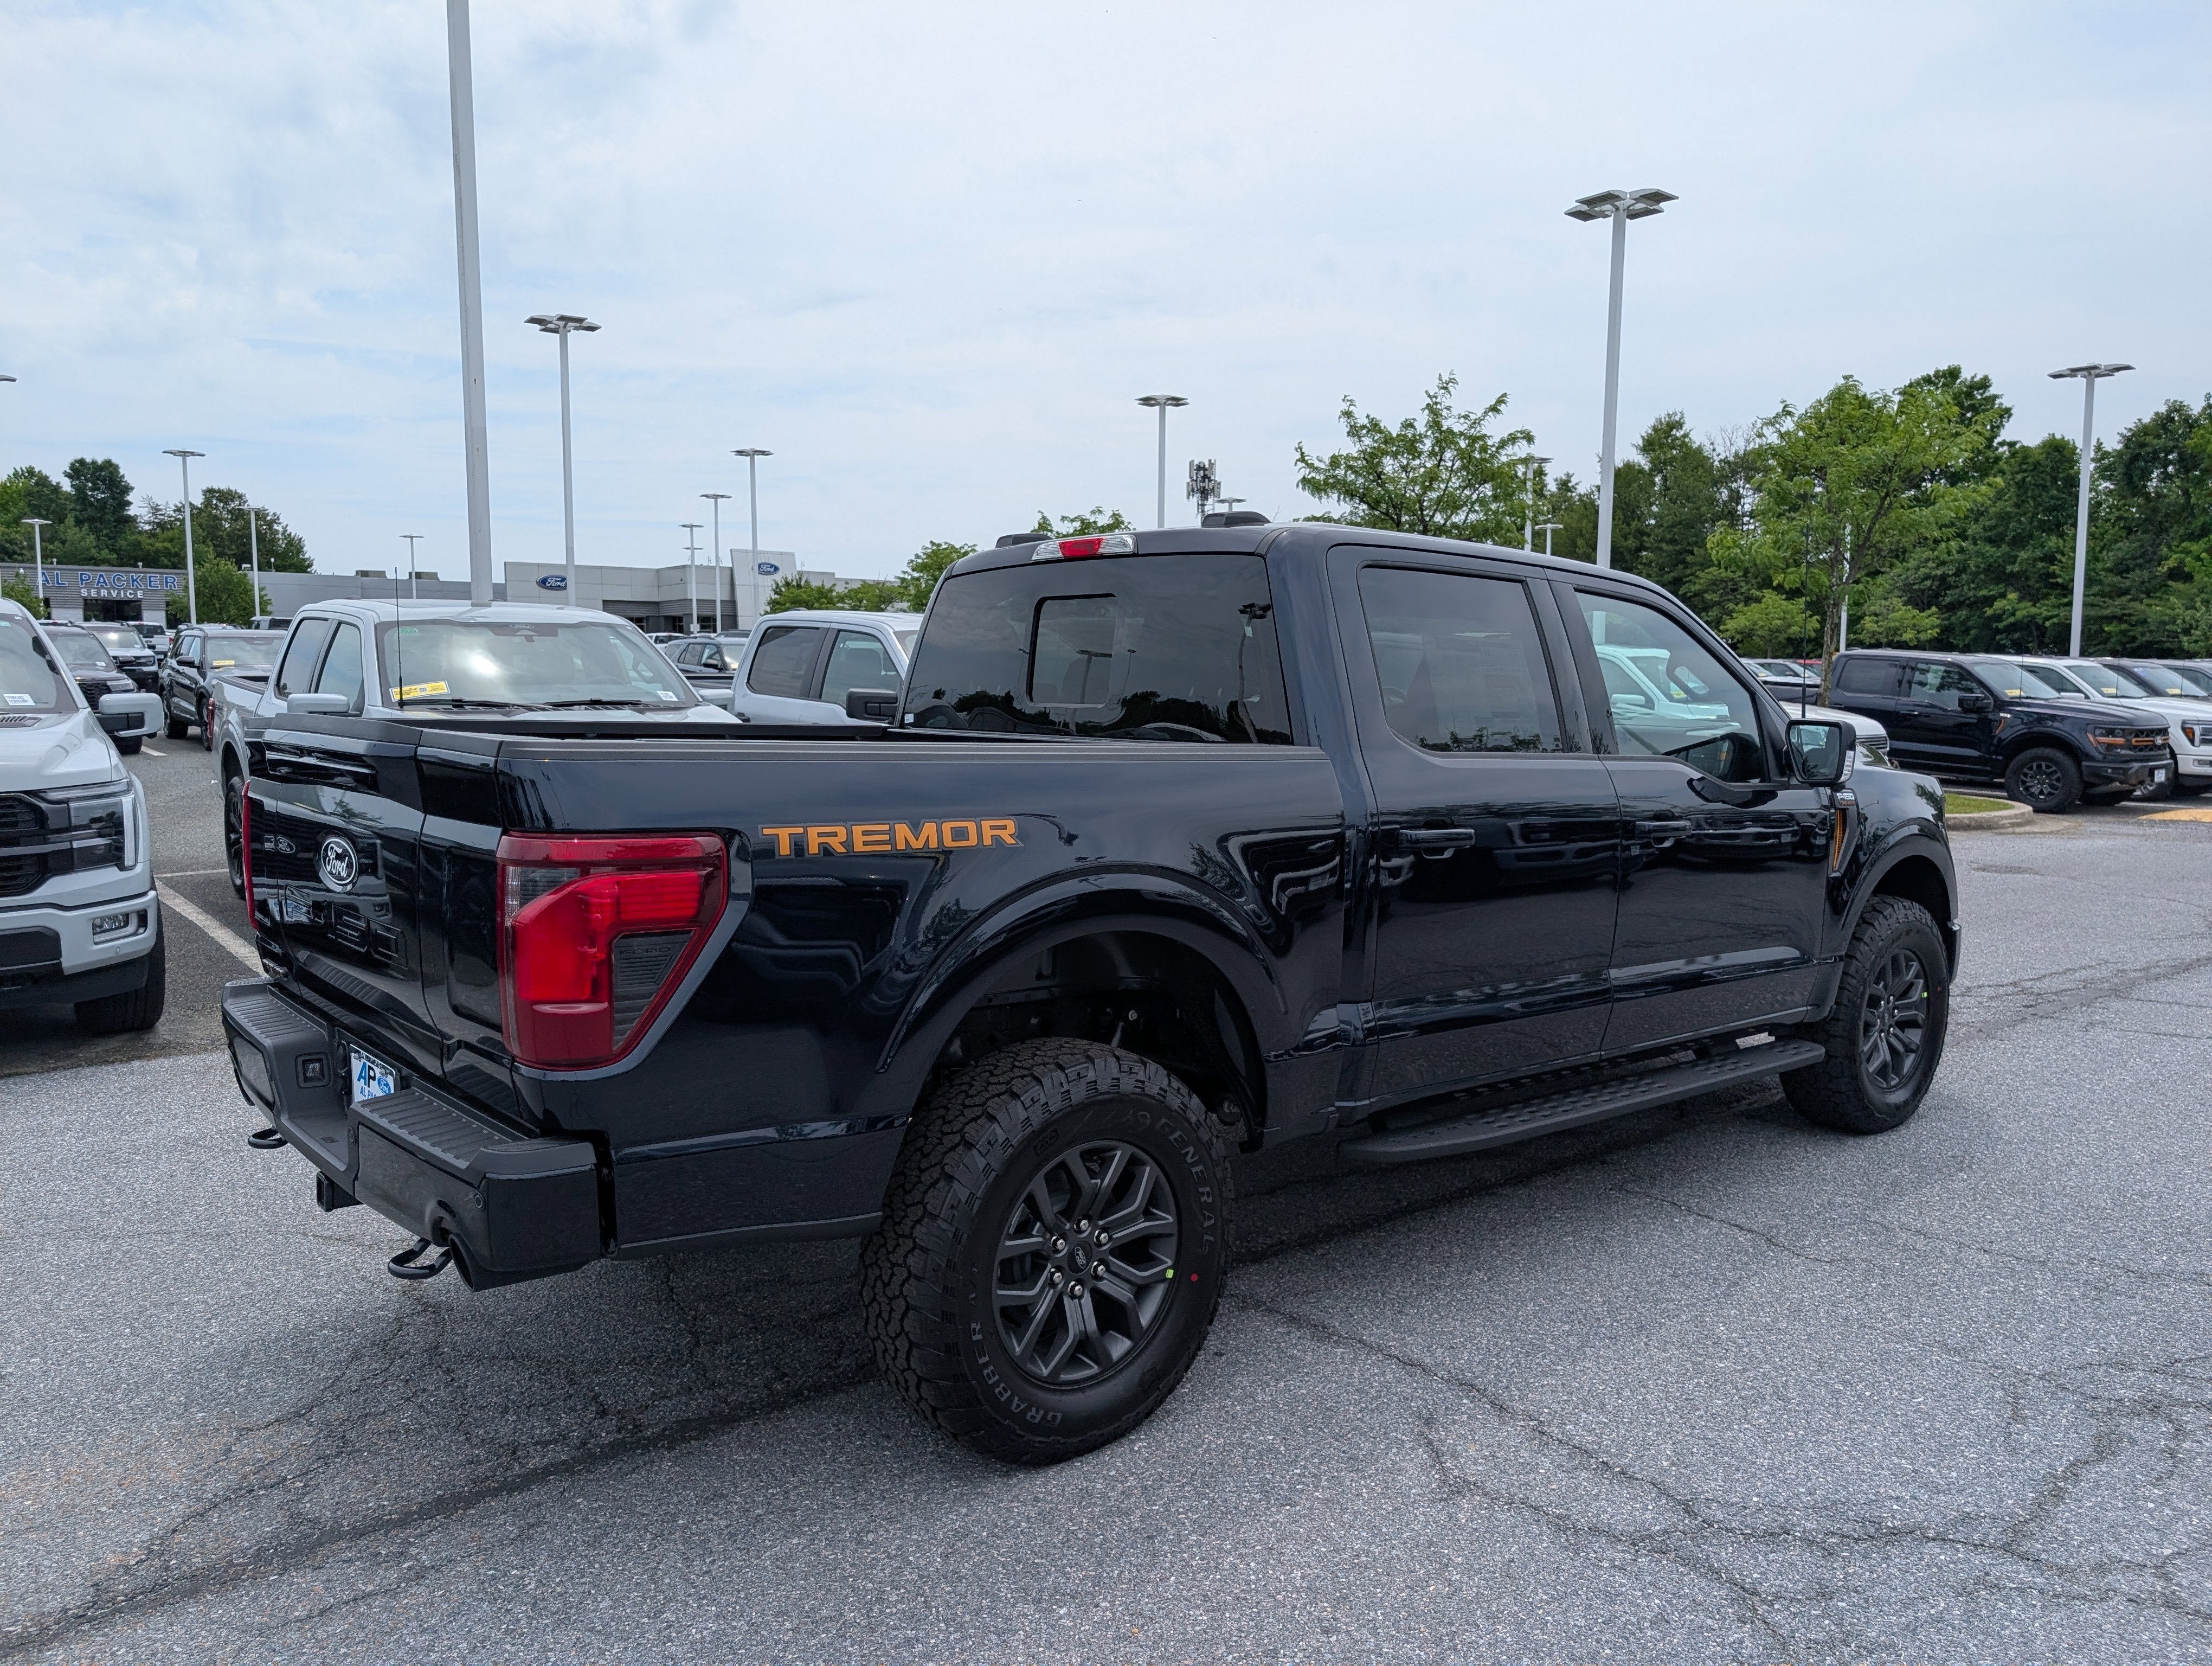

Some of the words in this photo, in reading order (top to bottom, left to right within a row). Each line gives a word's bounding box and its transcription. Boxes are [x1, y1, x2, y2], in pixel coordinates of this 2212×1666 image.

[36, 571, 68, 587] AL
[79, 571, 178, 590] PACKER
[545, 577, 567, 587] Ford
[81, 588, 144, 598] SERVICE
[760, 817, 1020, 857] TREMOR
[326, 843, 349, 878] Ford
[620, 946, 671, 956] FORD
[357, 1061, 376, 1088] AP
[359, 1085, 366, 1098] AL
[1155, 1118, 1215, 1254] GENERAL
[970, 1322, 1063, 1426] GRABBER
